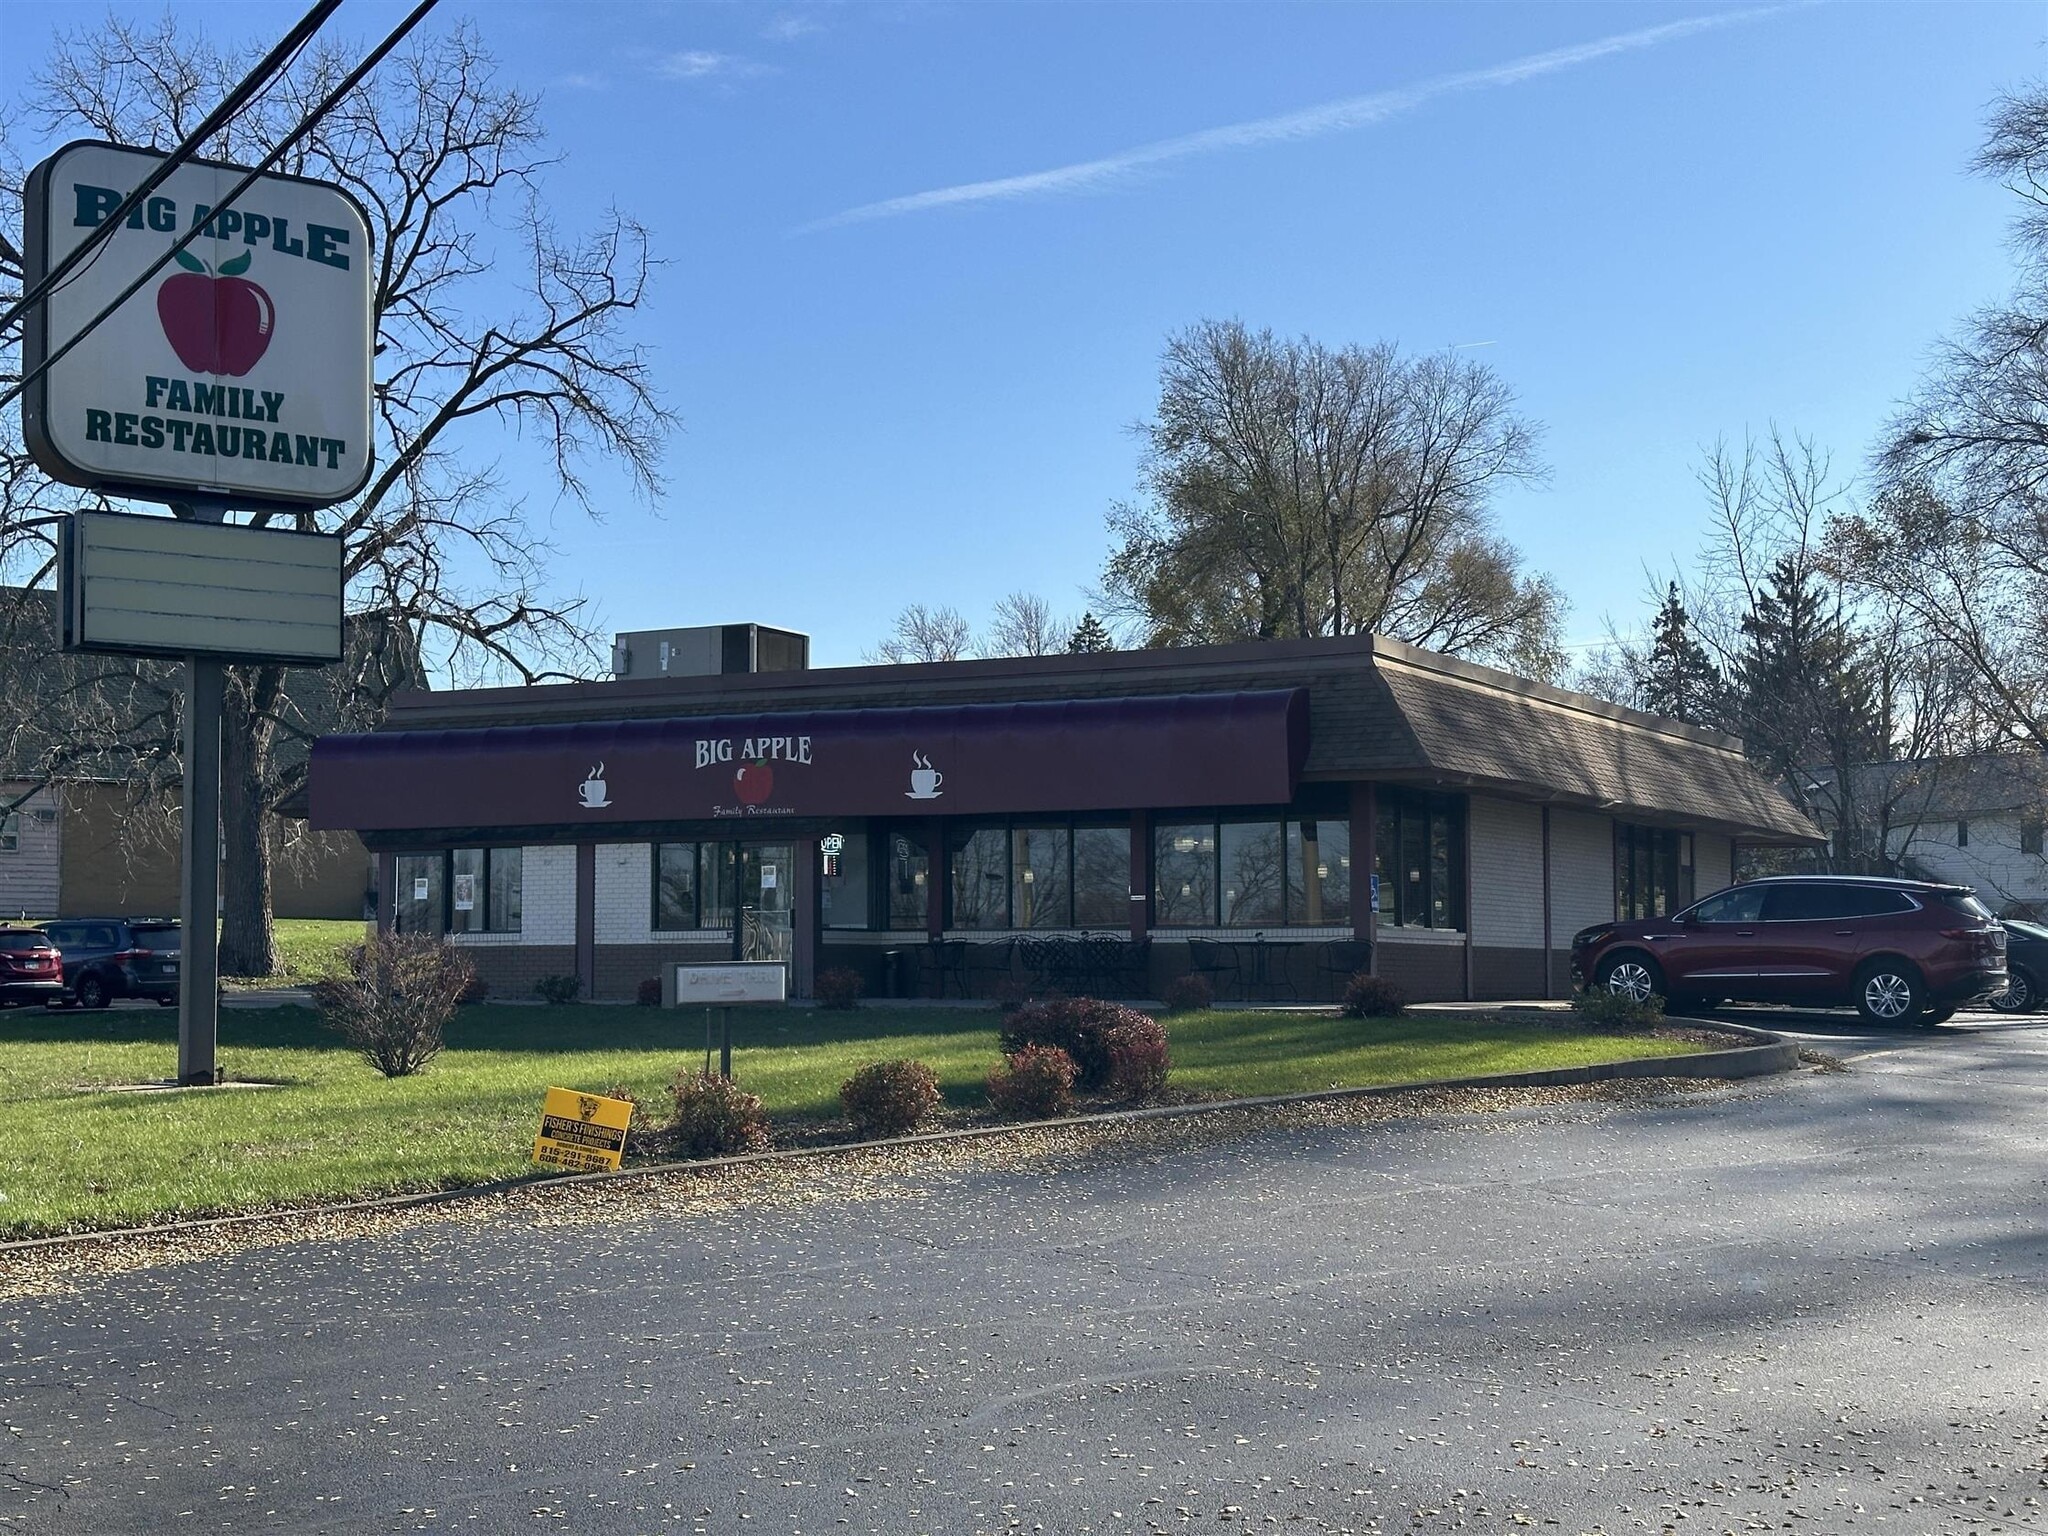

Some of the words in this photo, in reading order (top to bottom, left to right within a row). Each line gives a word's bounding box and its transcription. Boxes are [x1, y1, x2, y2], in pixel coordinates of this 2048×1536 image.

[73, 183, 177, 232] BIG
[190, 203, 350, 272] APPLE
[145, 375, 285, 423] FAMILY
[85, 408, 346, 470] RESTAURANT
[695, 739, 733, 769] BIG
[741, 736, 813, 765] APPLE
[712, 805, 743, 818] Family
[746, 804, 796, 815] Restaurant
[820, 836, 842, 849] OPEN
[544, 1116, 580, 1133] FISHER'S
[550, 1129, 581, 1143] CONCRETE
[581, 1136, 611, 1149] PROJECTS
